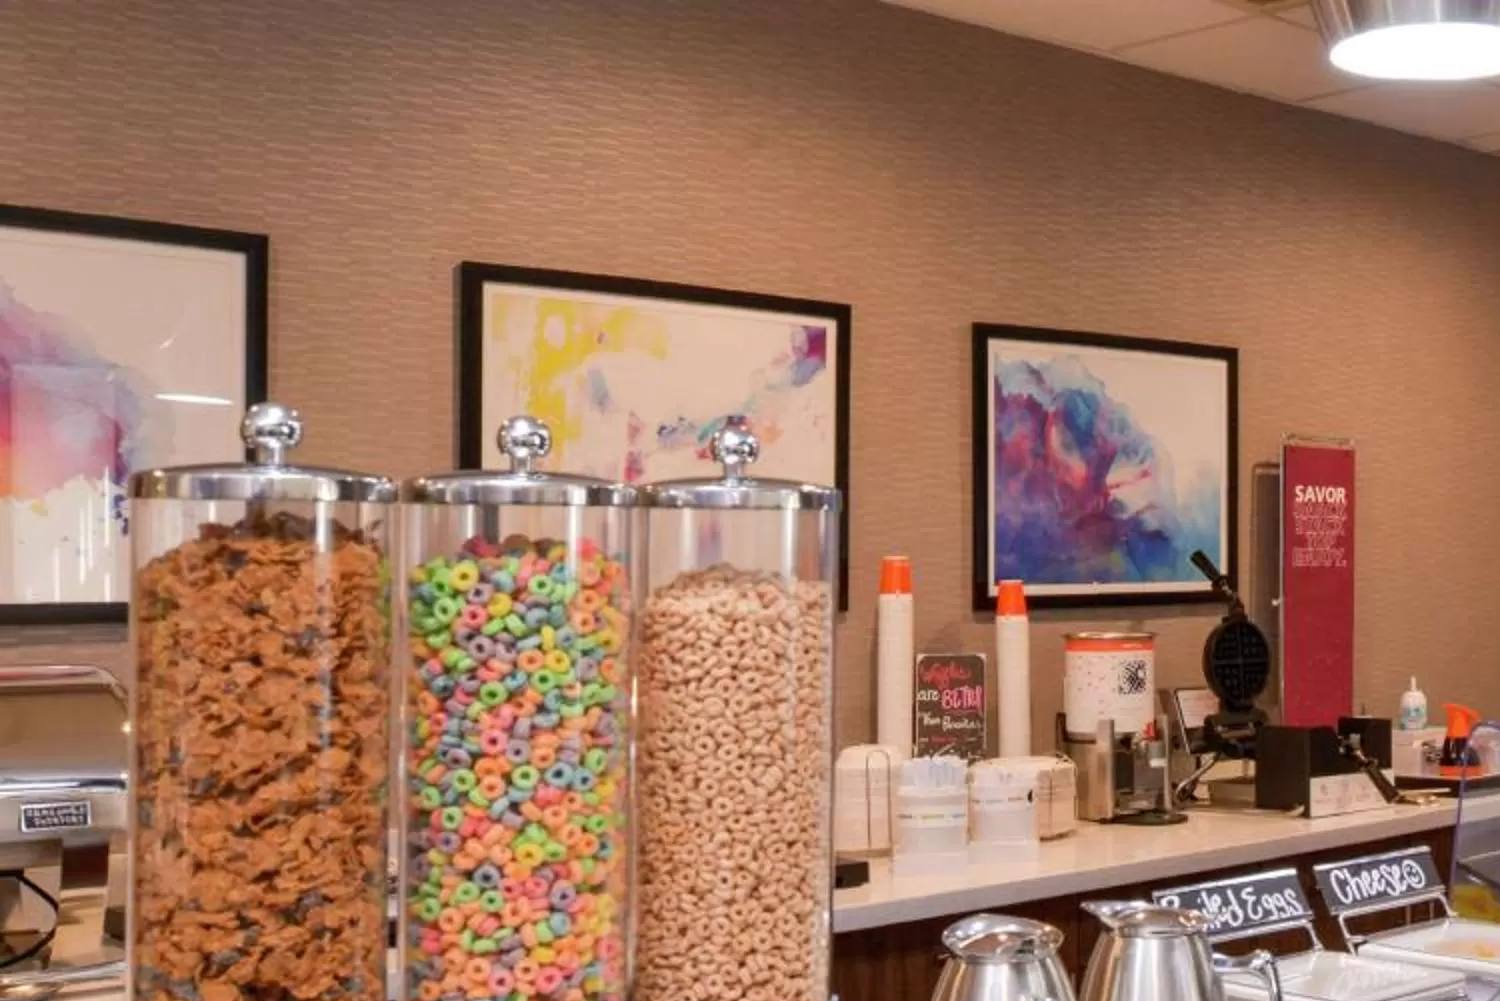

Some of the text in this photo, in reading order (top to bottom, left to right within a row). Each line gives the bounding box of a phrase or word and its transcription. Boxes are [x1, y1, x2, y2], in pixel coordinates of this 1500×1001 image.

[1295, 485, 1345, 504] SAVOR
[1330, 863, 1408, 904] Cheese
[1241, 884, 1305, 922] Eggs
